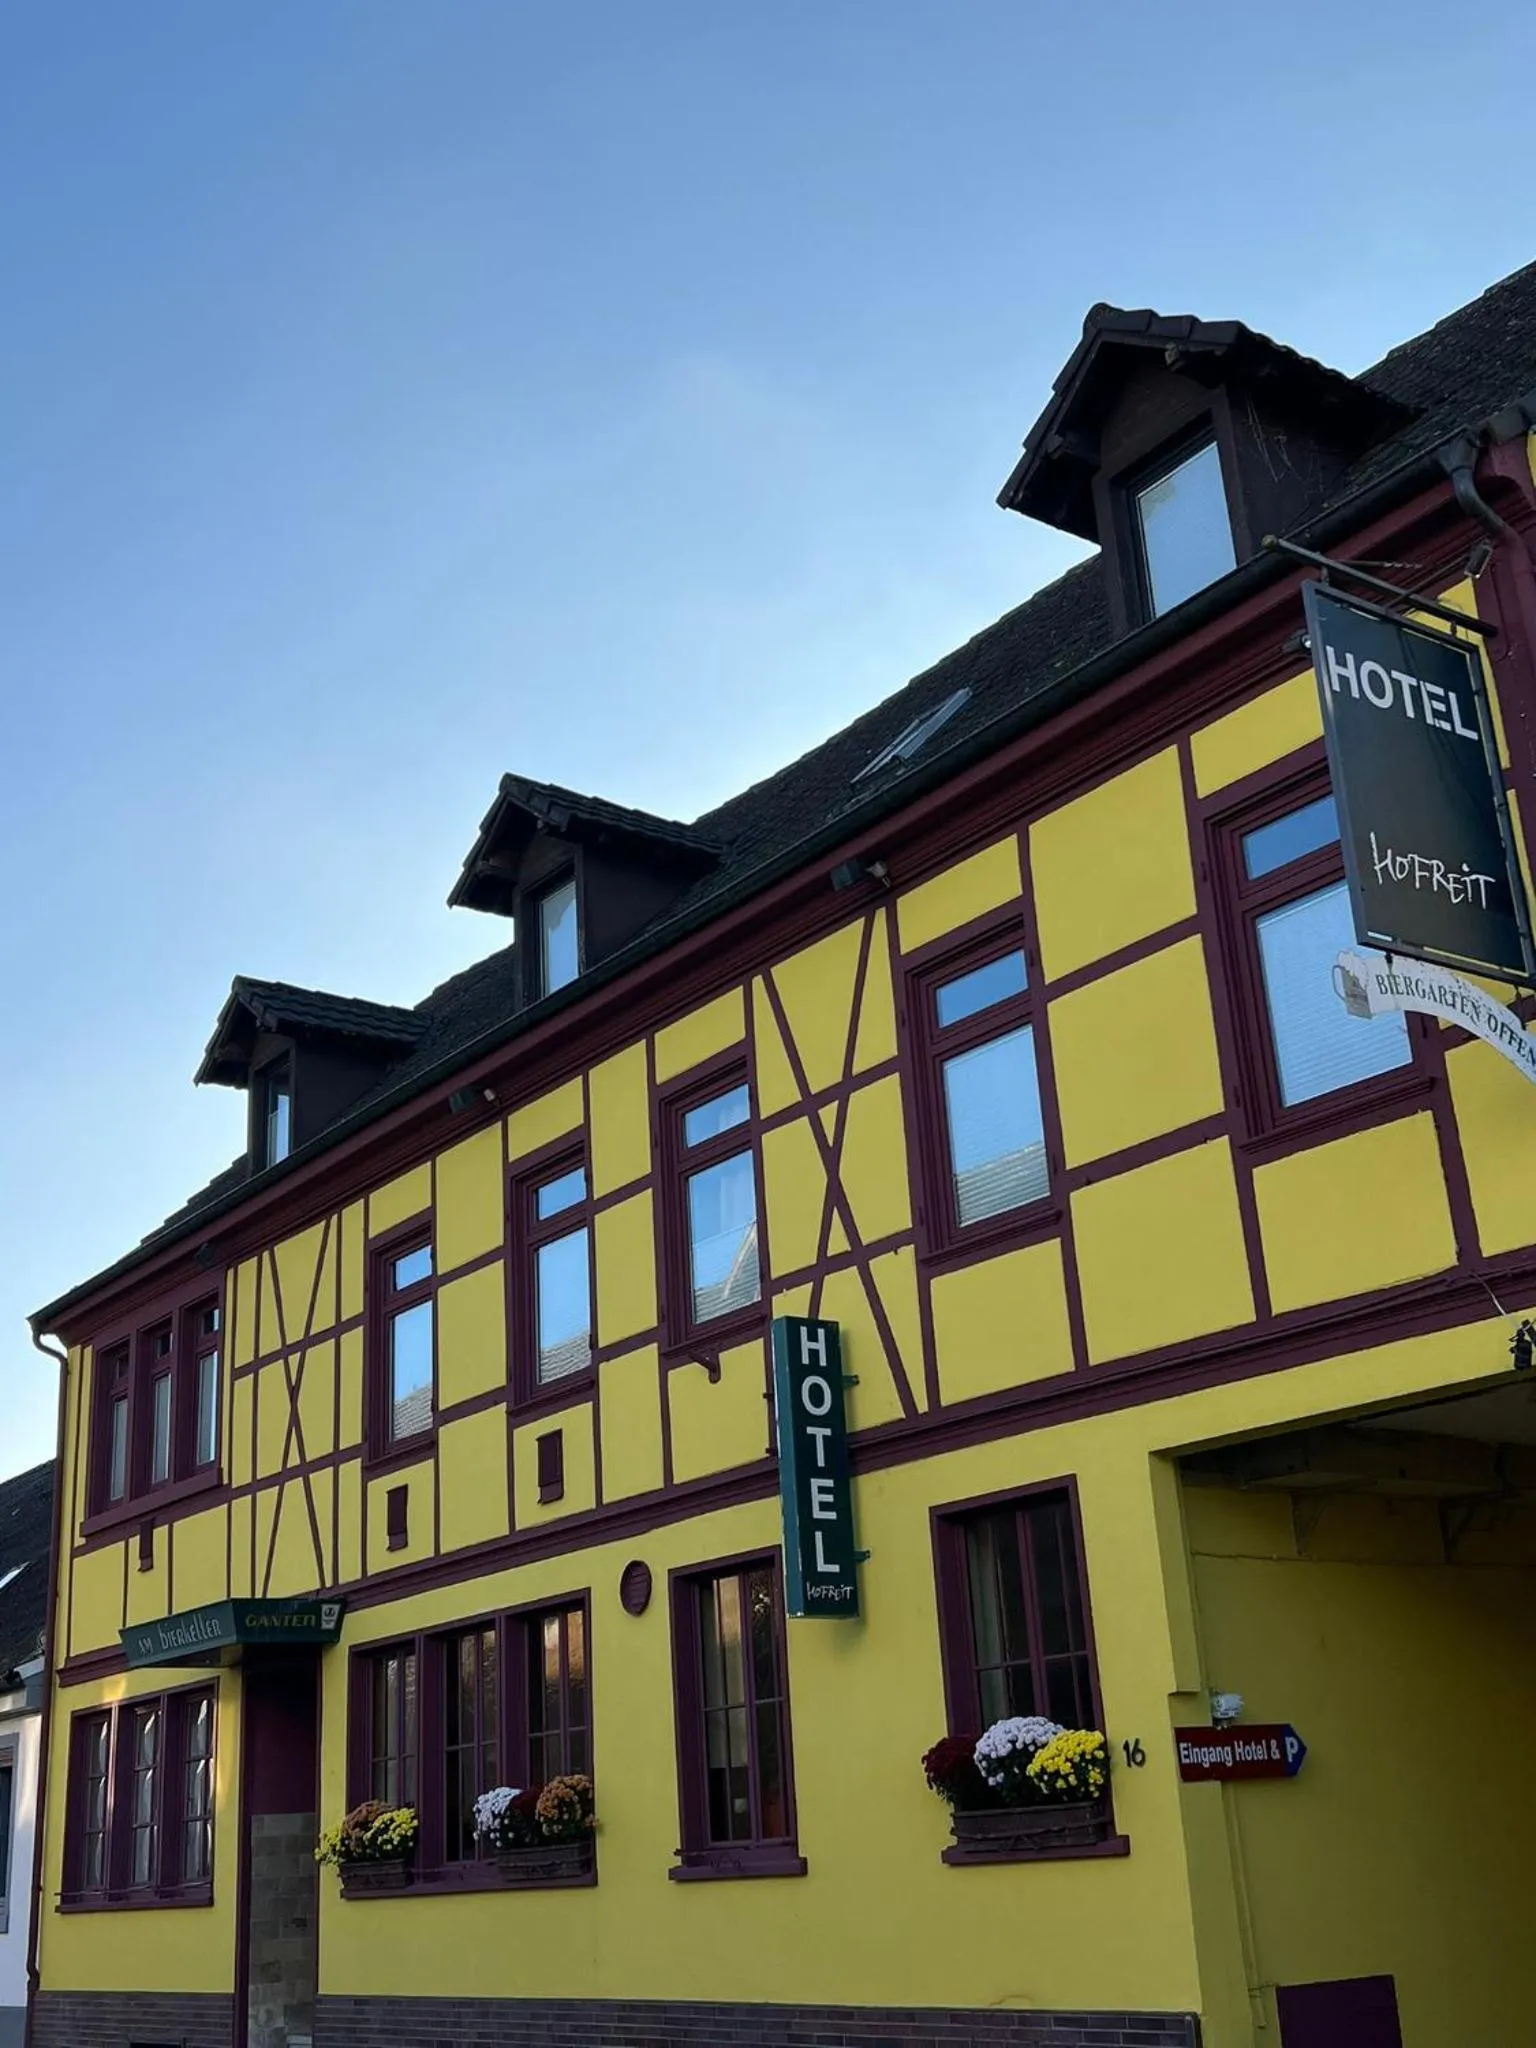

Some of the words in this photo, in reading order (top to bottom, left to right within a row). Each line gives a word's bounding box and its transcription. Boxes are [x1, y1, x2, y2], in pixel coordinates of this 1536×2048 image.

[1325, 645, 1479, 741] HOTEL
[1375, 973, 1481, 1022] BIERGARTEN
[799, 1325, 840, 1573] HOTEL
[1122, 1738, 1146, 1768] 16
[1179, 1742, 1233, 1768] Eingang
[1234, 1739, 1268, 1762] Hotel
[1271, 1741, 1281, 1760] &
[1285, 1736, 1299, 1763] P
